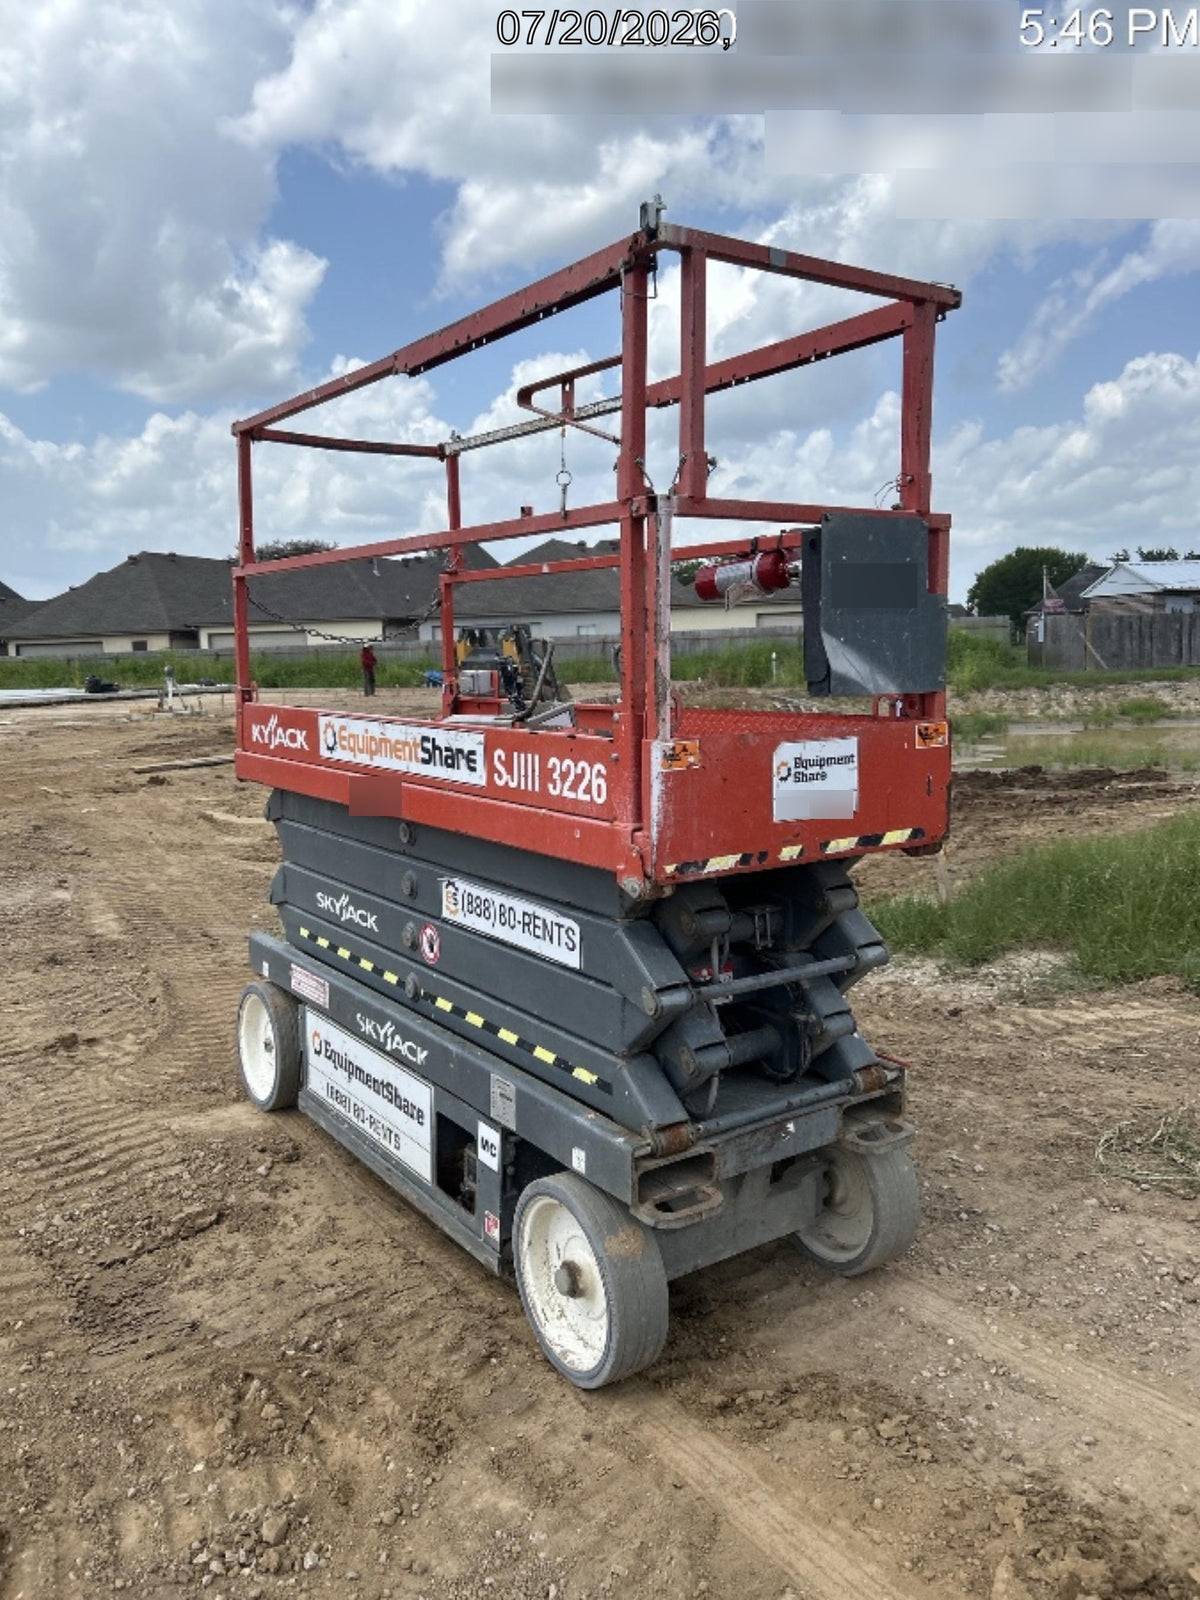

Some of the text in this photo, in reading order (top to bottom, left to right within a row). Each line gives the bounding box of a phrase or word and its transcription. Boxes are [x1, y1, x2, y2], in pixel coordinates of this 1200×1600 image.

[338, 724, 477, 772] EquipmentShare
[793, 752, 855, 770] Equipment
[493, 749, 607, 804] SJIII 3226
[793, 769, 827, 784] Share
[316, 890, 379, 932] SKYJACK
[355, 1012, 429, 1066] SKYJACK
[323, 1039, 425, 1127] EquipmentShare
